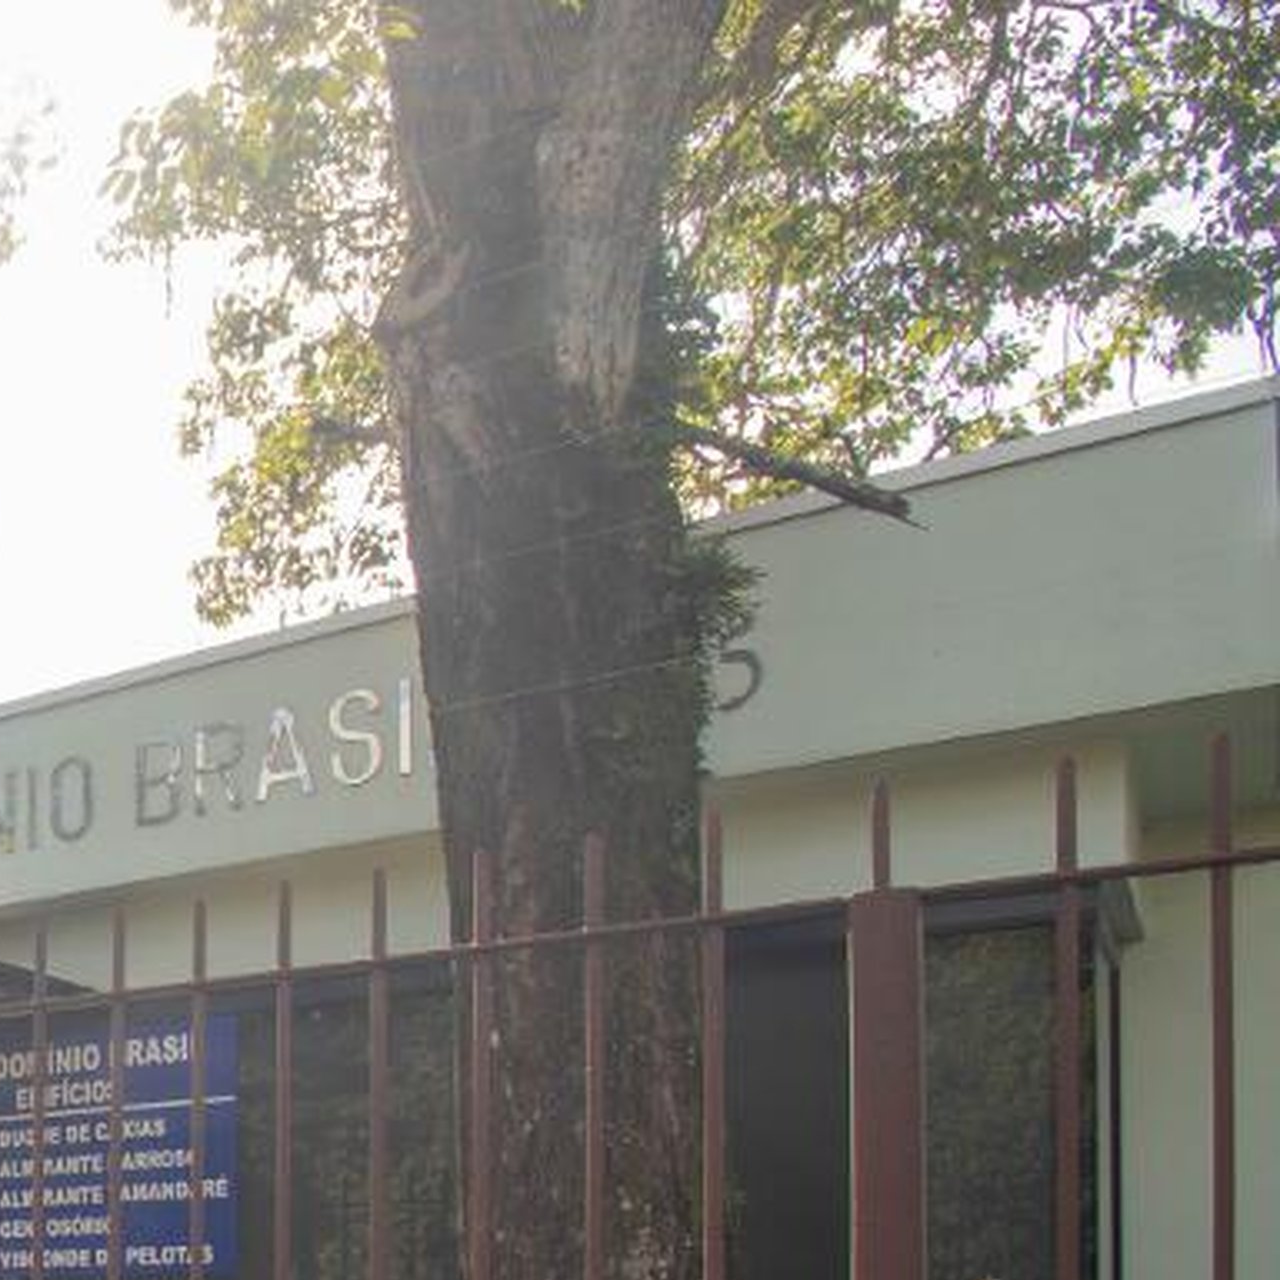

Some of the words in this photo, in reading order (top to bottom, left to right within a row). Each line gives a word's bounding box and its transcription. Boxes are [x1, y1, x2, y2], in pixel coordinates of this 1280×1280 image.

[134, 677, 436, 829] BRASI
[65, 1123, 91, 1144] DE
[95, 1119, 166, 1141] CXIAS
[0, 1151, 104, 1179] ALMRANTE
[0, 1185, 104, 1209] ALMRANTE
[119, 1173, 229, 1201] AMANDRÉ
[125, 1244, 214, 1267] PELOTS
